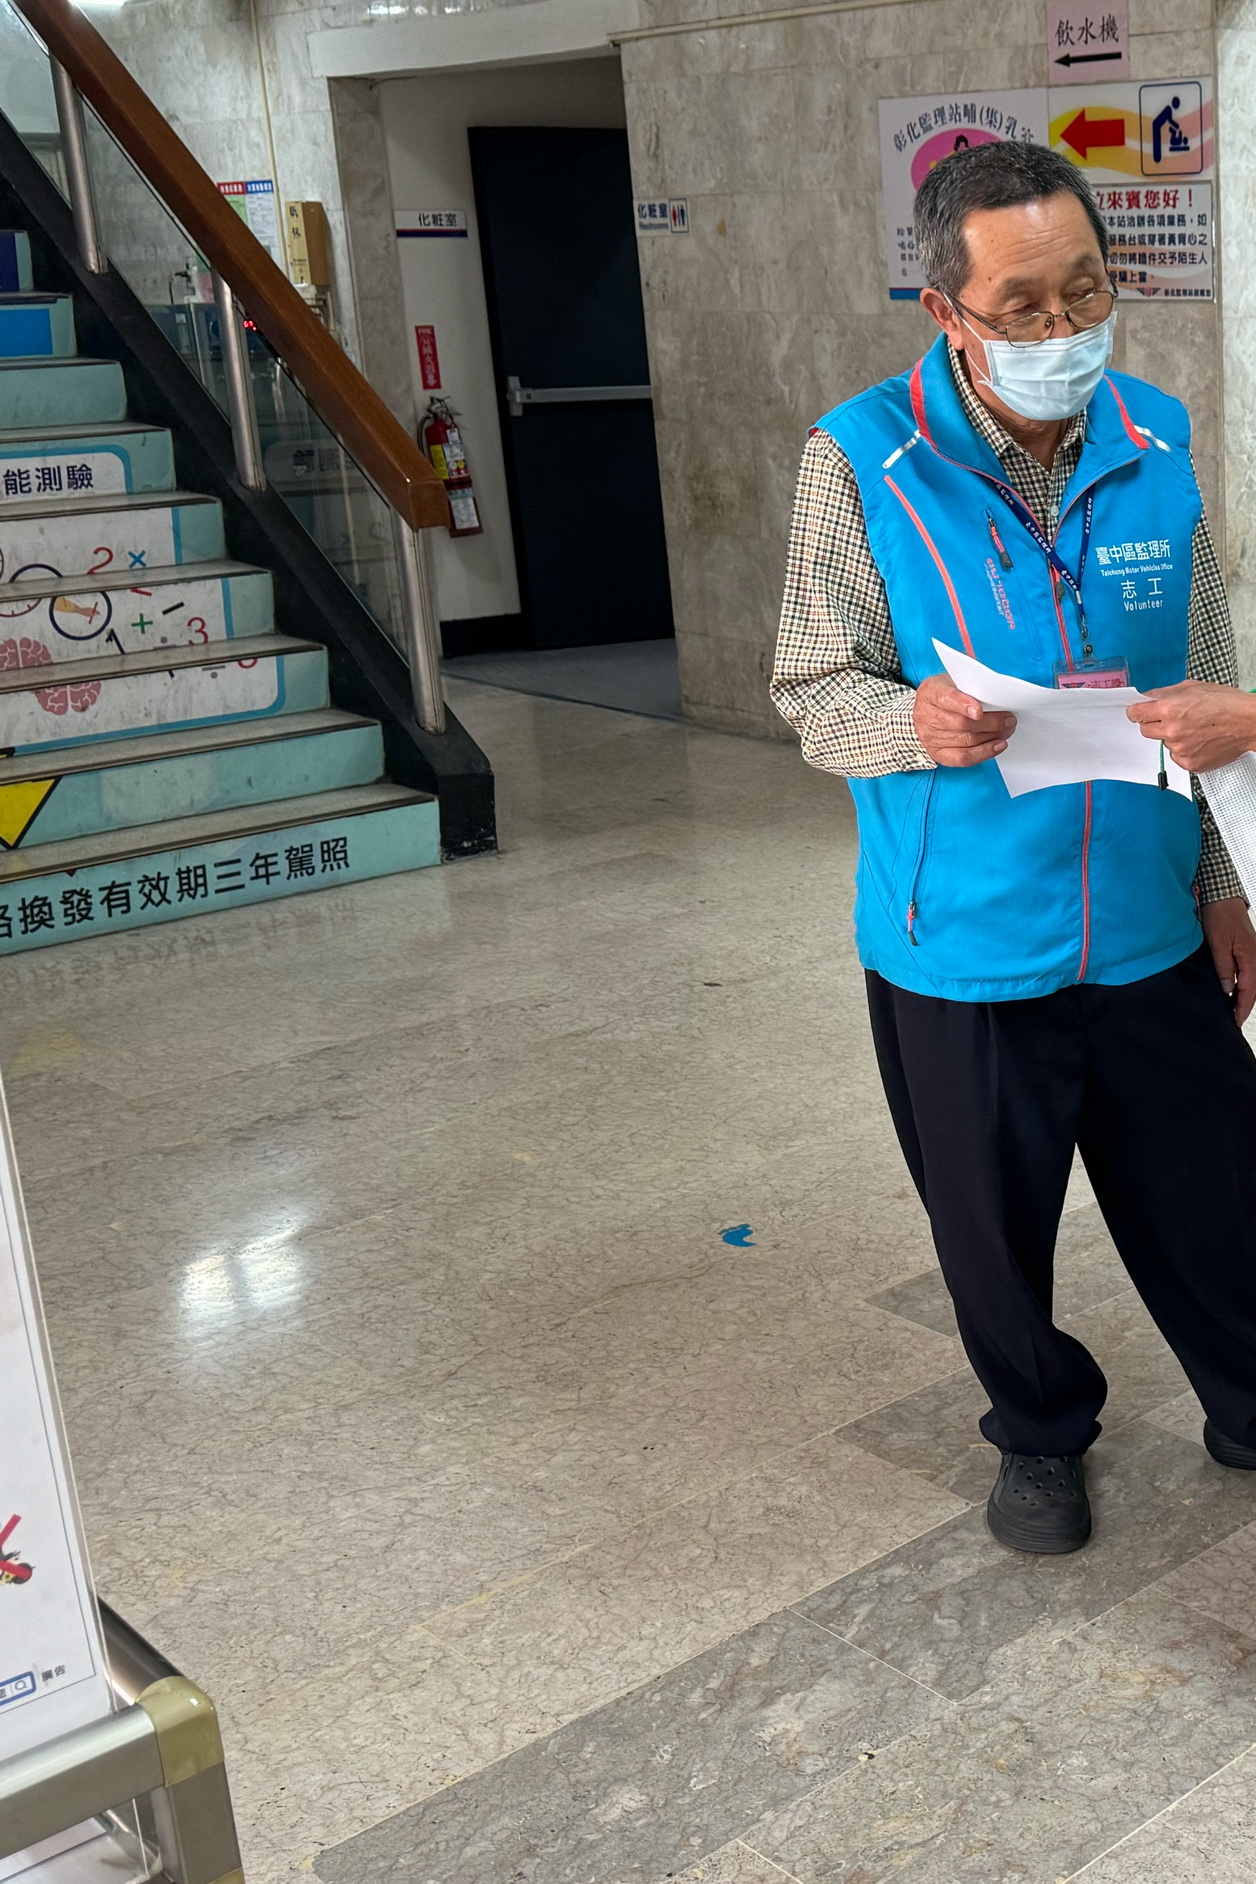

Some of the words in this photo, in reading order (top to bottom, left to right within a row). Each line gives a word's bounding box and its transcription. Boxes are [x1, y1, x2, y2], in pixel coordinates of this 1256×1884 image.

[1055, 13, 1120, 47] 飲水機
[418, 212, 457, 228] 化粧室
[2, 462, 95, 496] 能測驗
[1095, 539, 1171, 566] 臺中區監理所
[1123, 599, 1163, 612] Volunteer
[41, 1664, 66, 1682] 廣告
